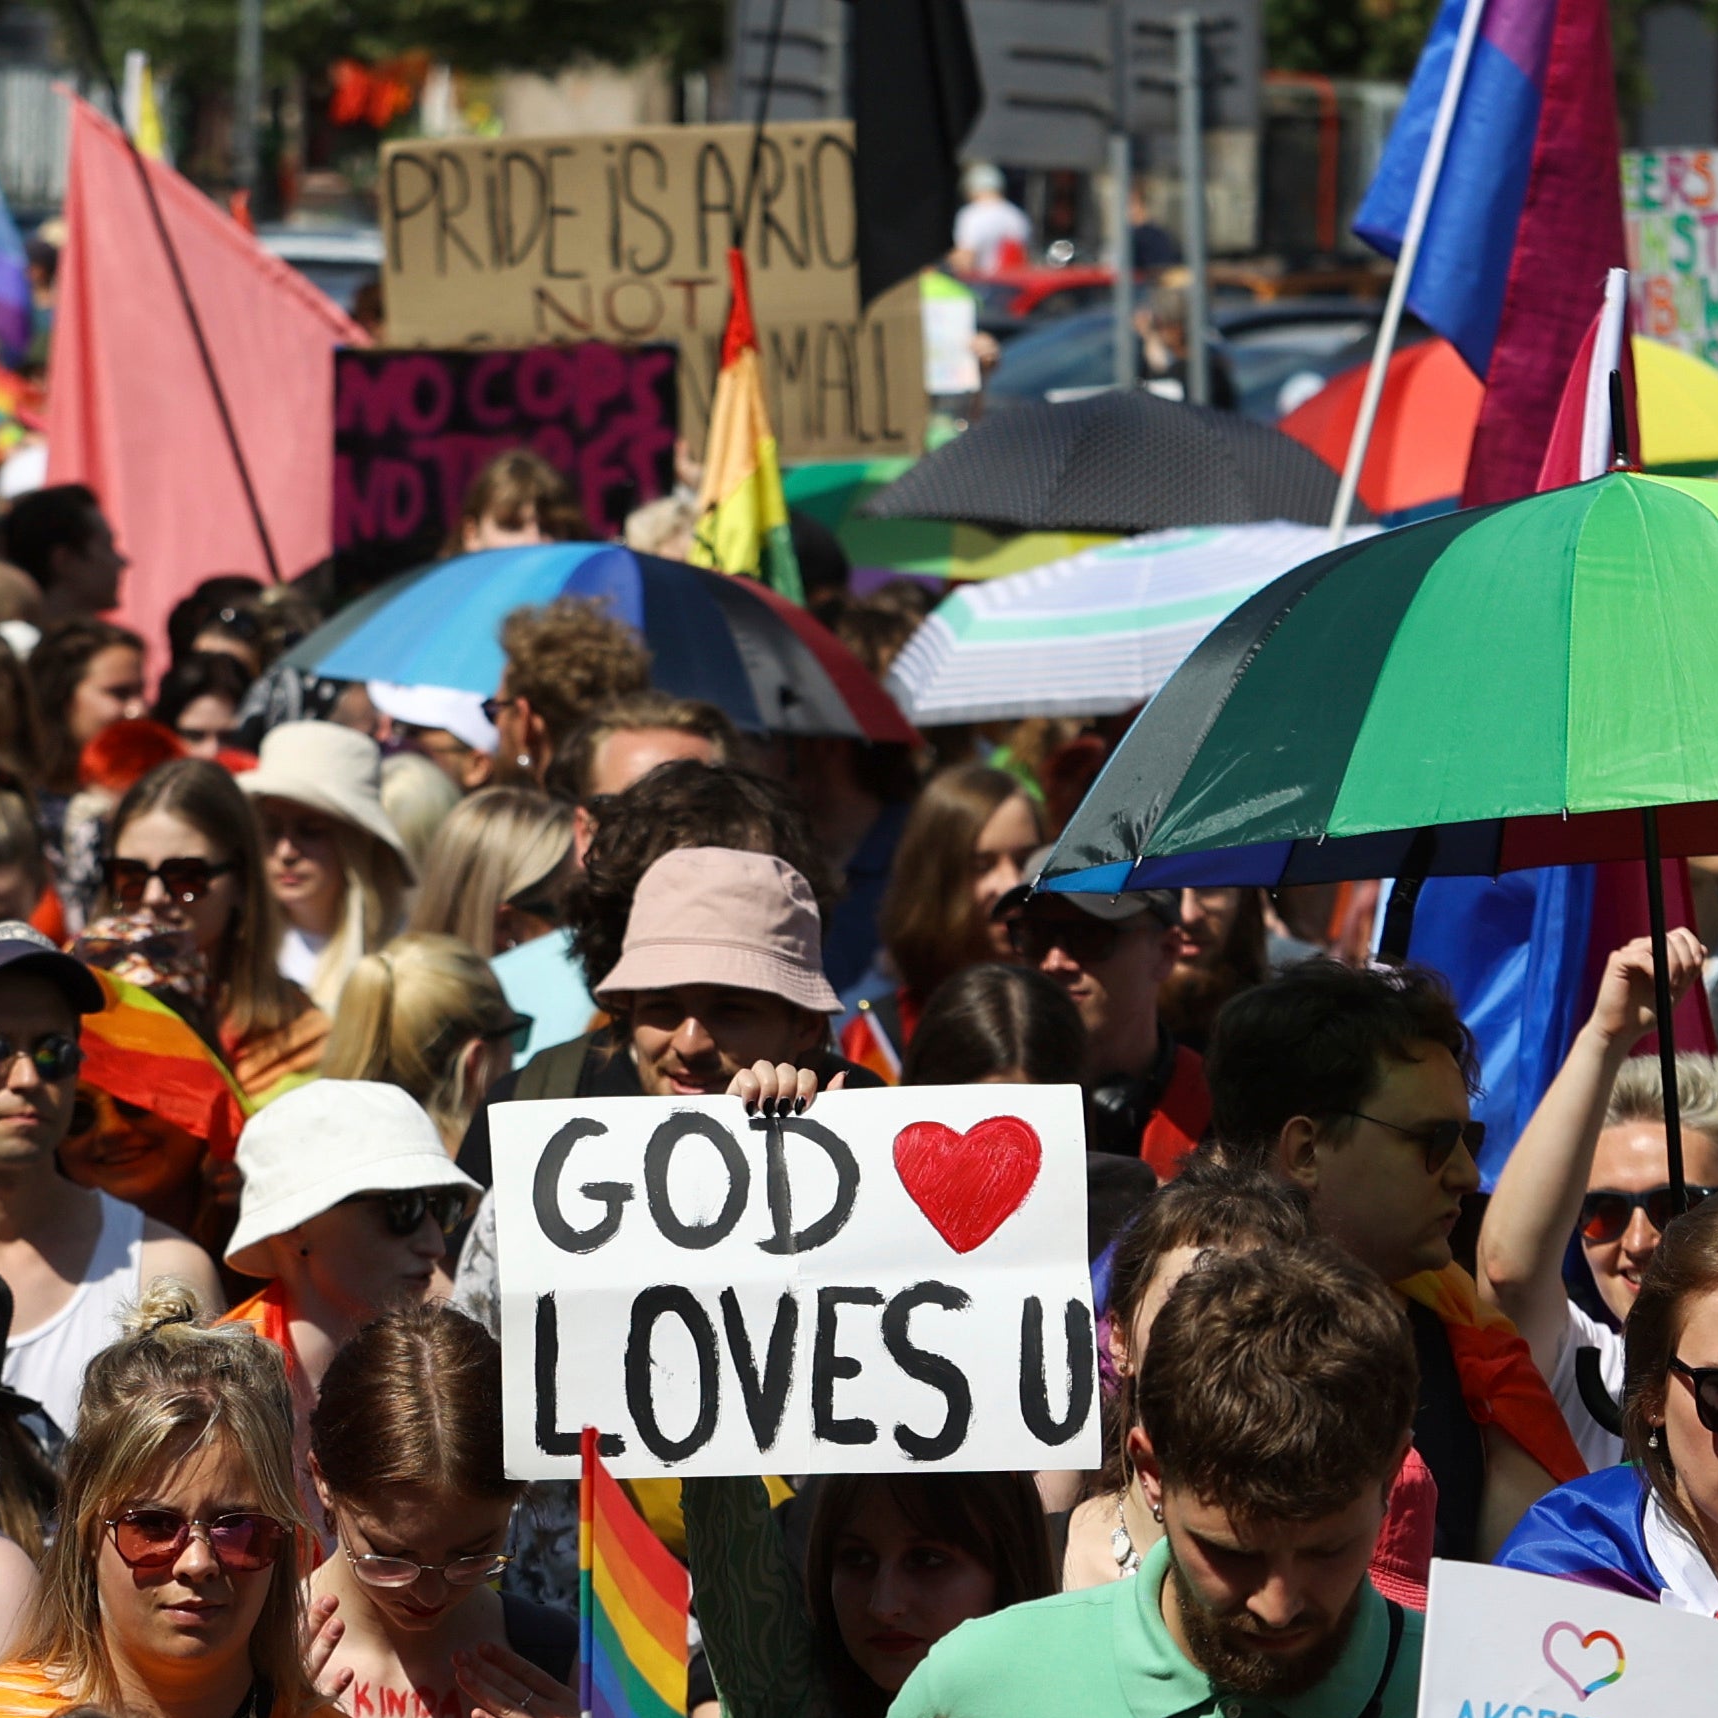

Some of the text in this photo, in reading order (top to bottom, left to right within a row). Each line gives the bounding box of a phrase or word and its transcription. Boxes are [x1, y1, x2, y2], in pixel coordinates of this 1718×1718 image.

[533, 277, 717, 338] NOT
[335, 355, 455, 436] NO
[466, 341, 674, 428] COPS
[532, 1107, 861, 1256] GOD
[534, 1279, 1095, 1467] LOVES U
